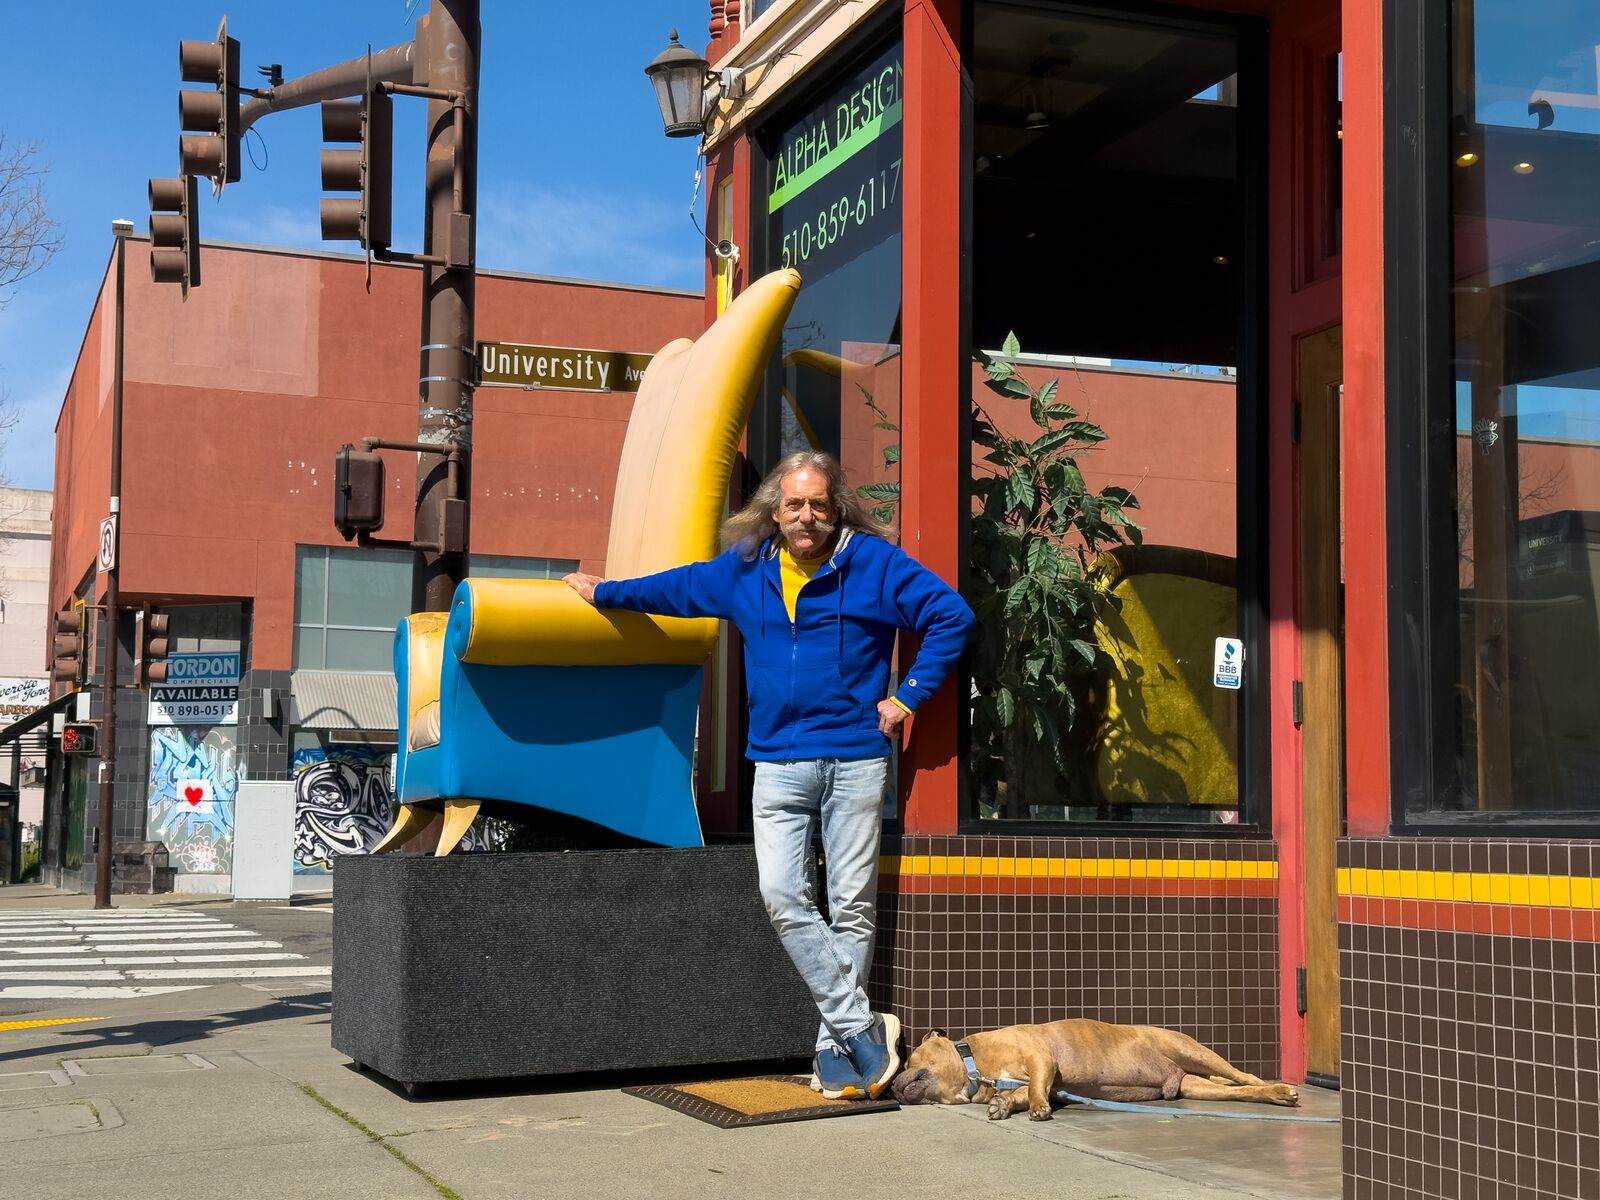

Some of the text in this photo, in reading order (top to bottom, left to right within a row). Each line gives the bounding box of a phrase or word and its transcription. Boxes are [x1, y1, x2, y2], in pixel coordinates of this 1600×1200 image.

[775, 117, 831, 192] ALPHA
[780, 158, 903, 269] 510-859-6117
[482, 346, 646, 389] University Ave
[1219, 664, 1237, 674] BBB
[0, 679, 38, 698] verette
[21, 686, 51, 702] Jone
[153, 688, 236, 700] AVAILABLE
[157, 704, 234, 716] 510 898-0513
